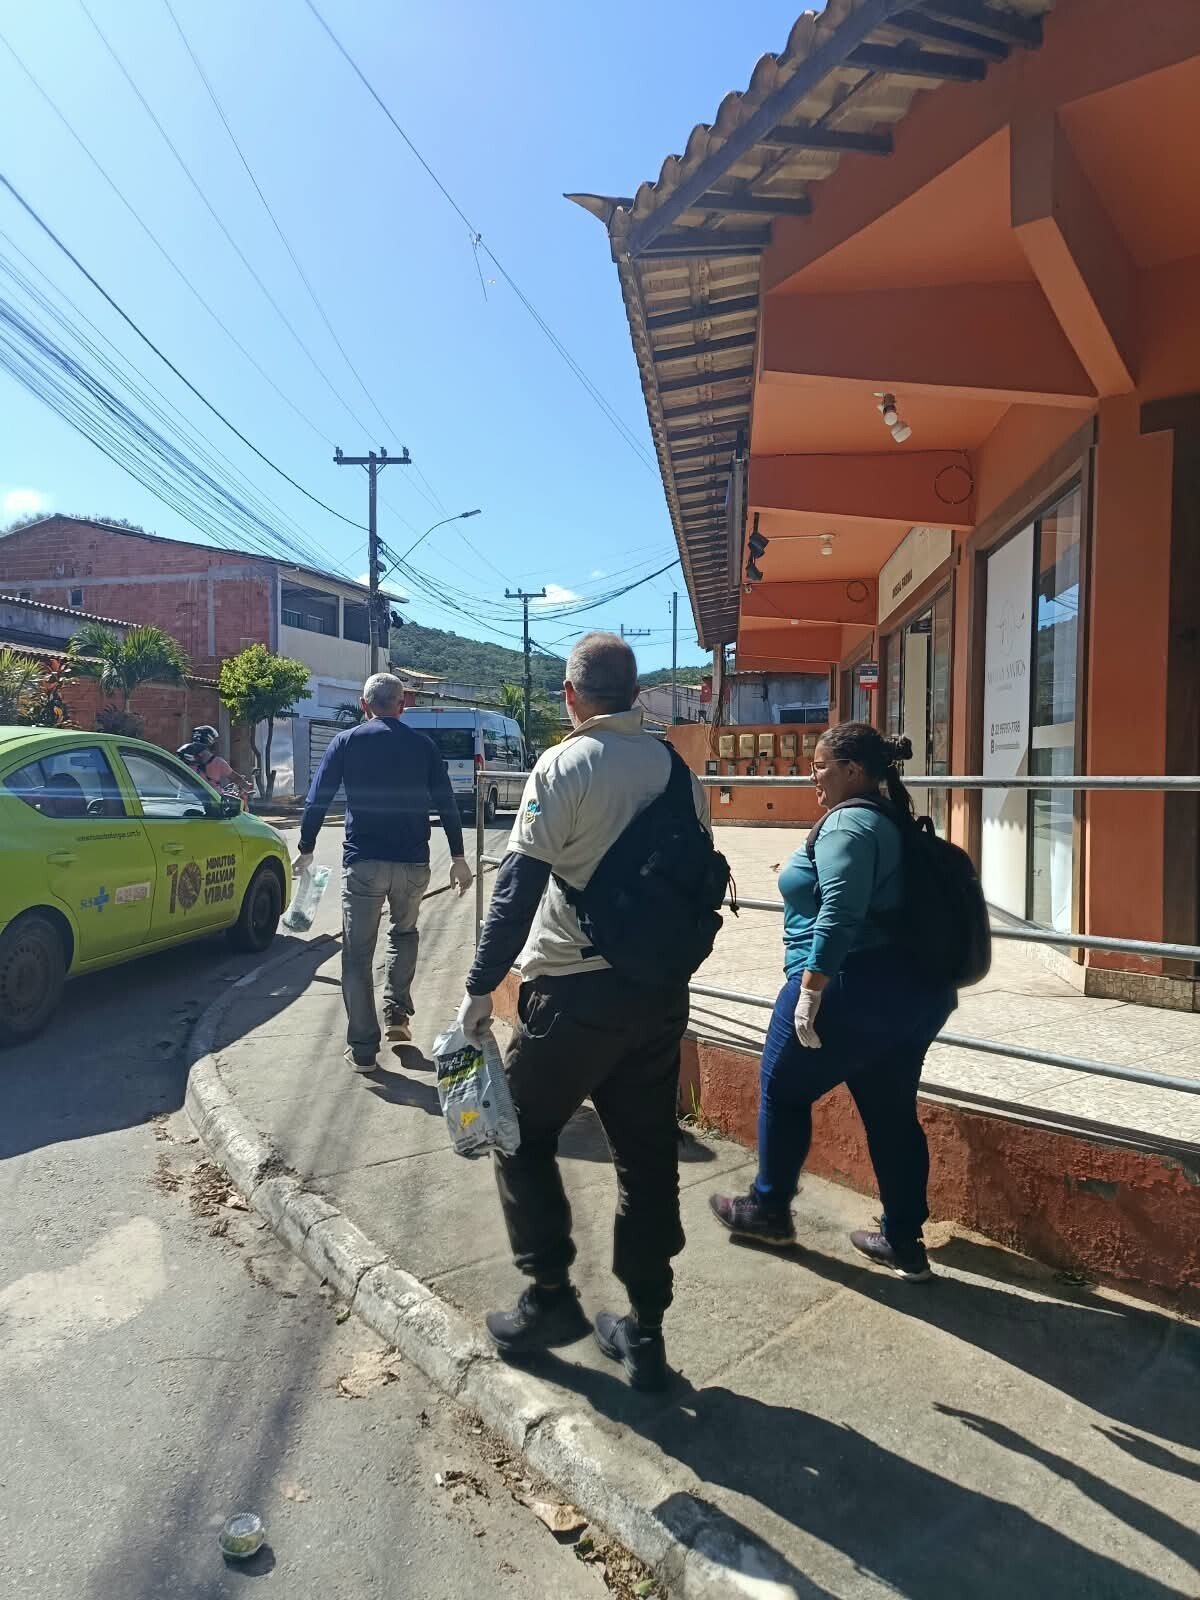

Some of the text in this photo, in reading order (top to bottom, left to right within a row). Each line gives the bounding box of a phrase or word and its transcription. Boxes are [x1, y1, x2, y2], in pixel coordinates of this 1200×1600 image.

[206, 854, 236, 871] MINUTOS
[205, 867, 236, 886] SALVAM
[204, 882, 234, 905] VIDAS
